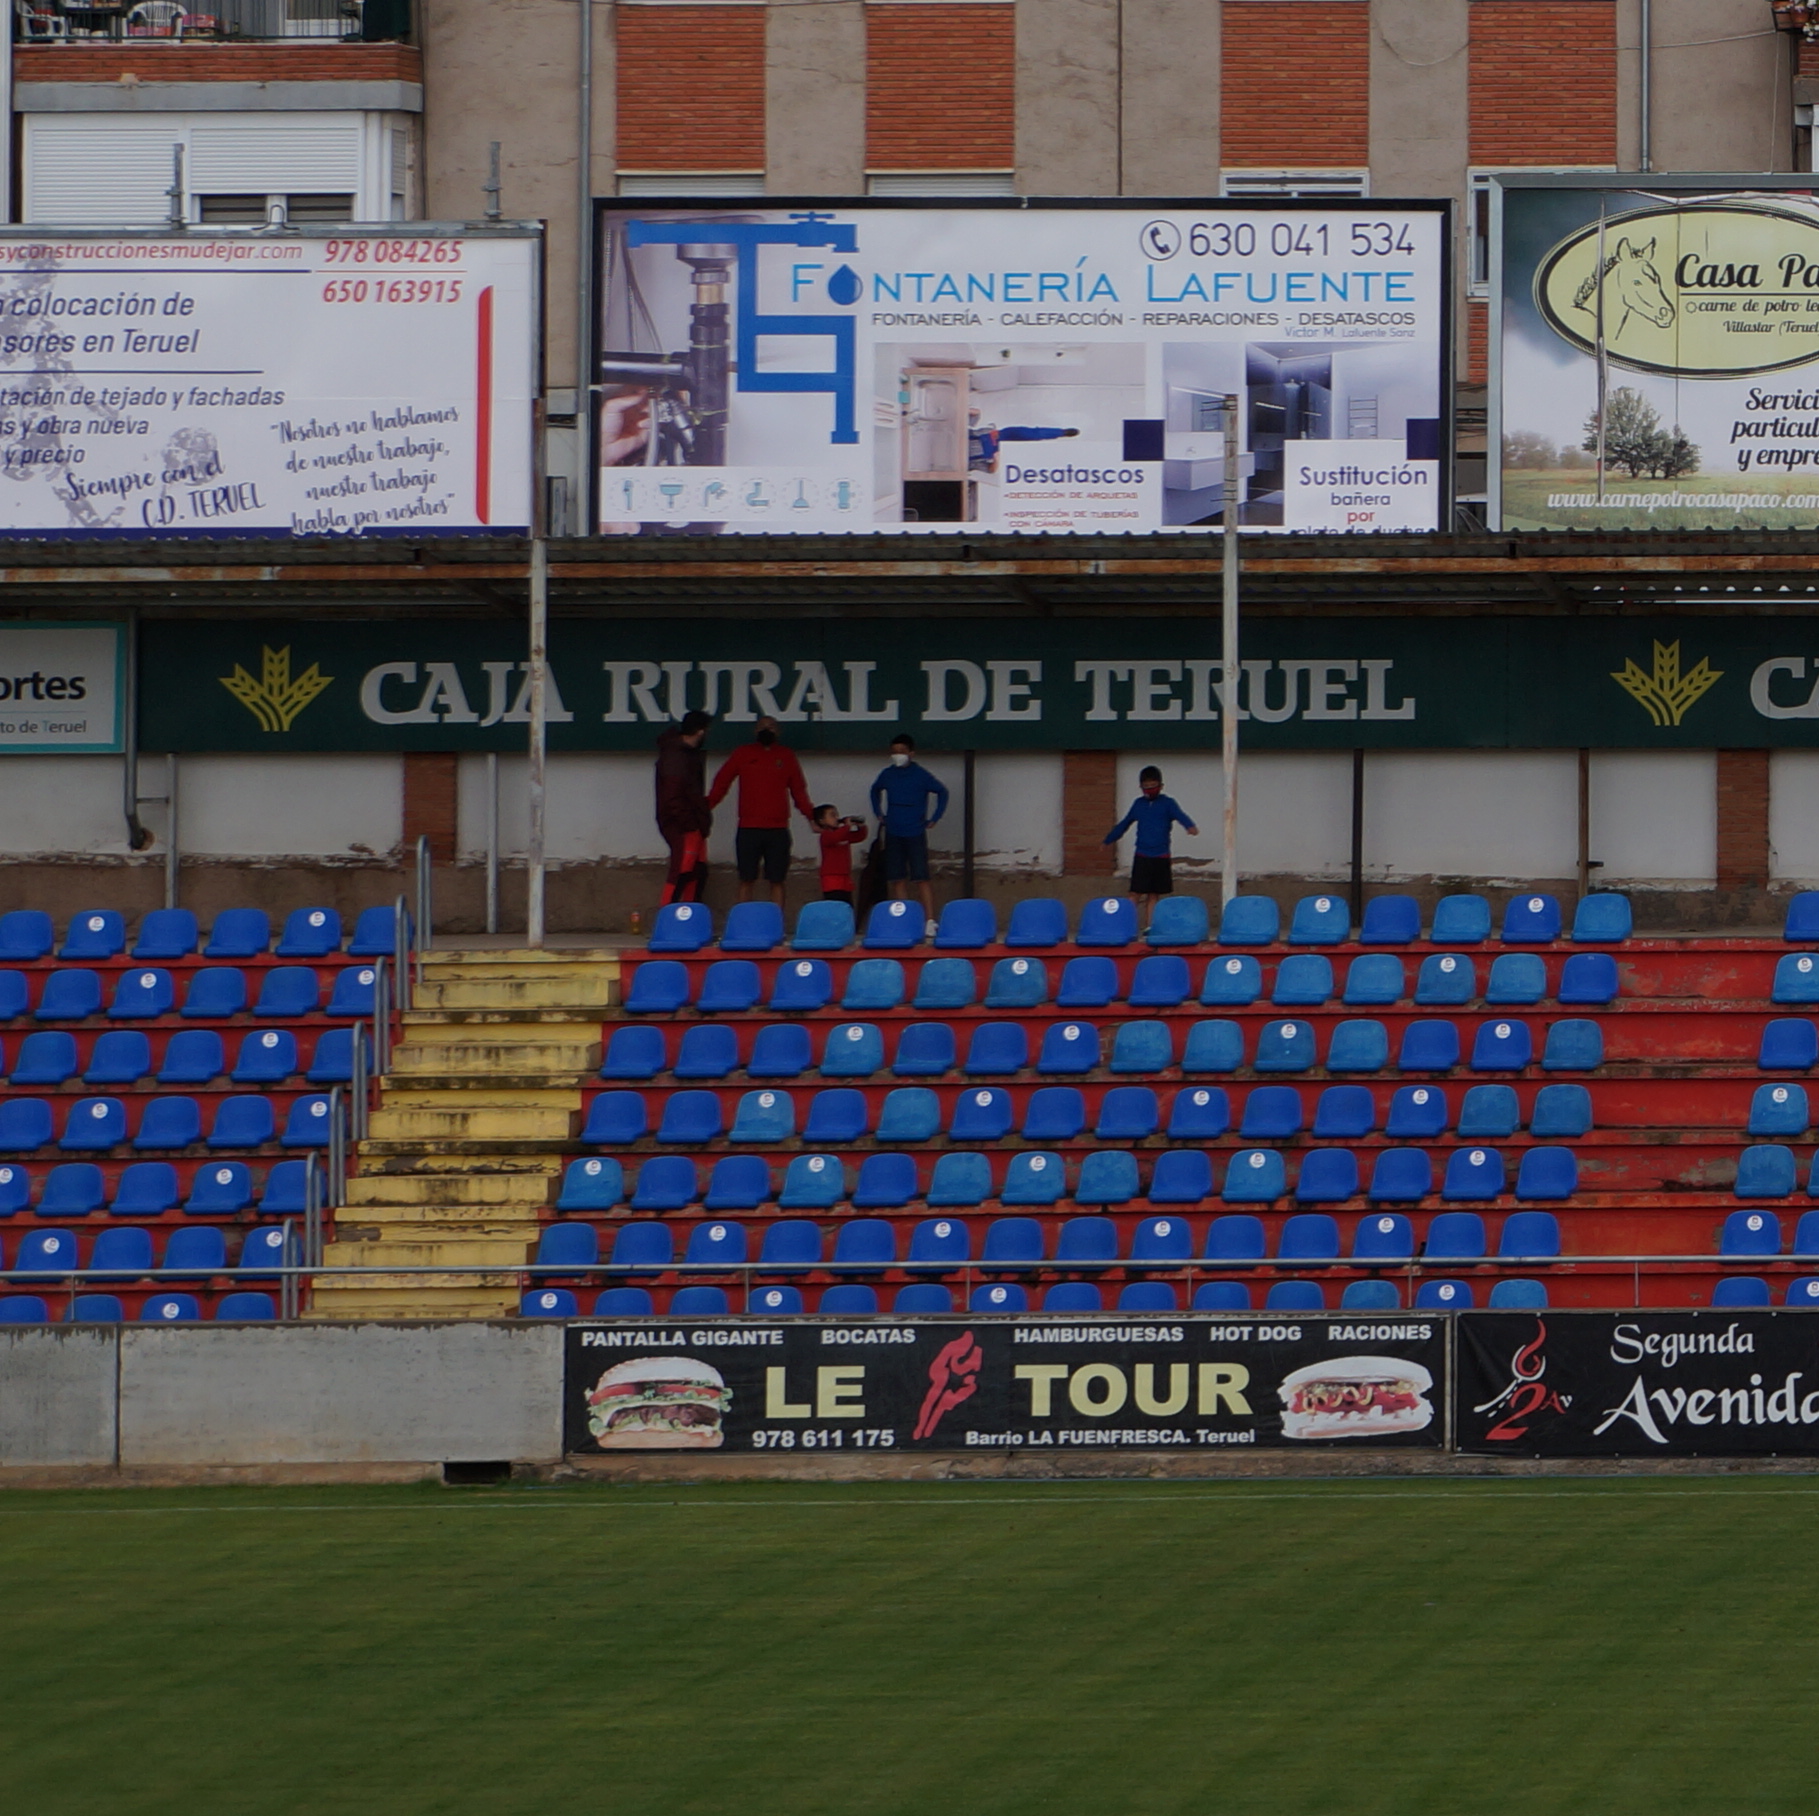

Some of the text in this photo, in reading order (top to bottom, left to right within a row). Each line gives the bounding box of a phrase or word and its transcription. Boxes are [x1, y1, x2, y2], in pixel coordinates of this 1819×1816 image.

[1190, 222, 1415, 256] 630 041 534
[324, 240, 462, 264] 978 084265
[1675, 253, 1763, 288] Casa
[323, 280, 461, 303] 650 163915
[1147, 264, 1415, 303] LAFUENTE
[11, 292, 194, 316] colocación de
[872, 308, 1415, 326] FONTANERÍA CALEFACCIÓN REPARACIONES DESATASCOS
[82, 329, 200, 353] en Teruel
[70, 387, 285, 410] de tejado fachadas
[36, 416, 149, 435] obra nueva
[370, 406, 459, 432] hablamos
[20, 445, 85, 469] precio
[313, 443, 374, 469] nuestro
[306, 468, 437, 500] nuestro trabajo
[1005, 463, 1144, 484] Desatascos
[1300, 464, 1427, 485] Sustitución
[66, 471, 156, 501] Siempre
[187, 481, 266, 518] TERUEL
[1330, 492, 1391, 505] bañera
[1347, 511, 1375, 525] por
[360, 658, 1416, 727] CAJA RURAL DE TERUEL
[42, 719, 87, 733] Teruel
[581, 1324, 1432, 1347] PANTALLA GIGANTE BOCATAS HAMBURGUESAS HOT DOG RACIONES
[1610, 1323, 1755, 1368] Segunda
[765, 1362, 1253, 1419] LE TOUR
[752, 1429, 895, 1447] 978 611 175
[965, 1429, 1256, 1445] Barrio LA FUENFRESCA. Teruel
